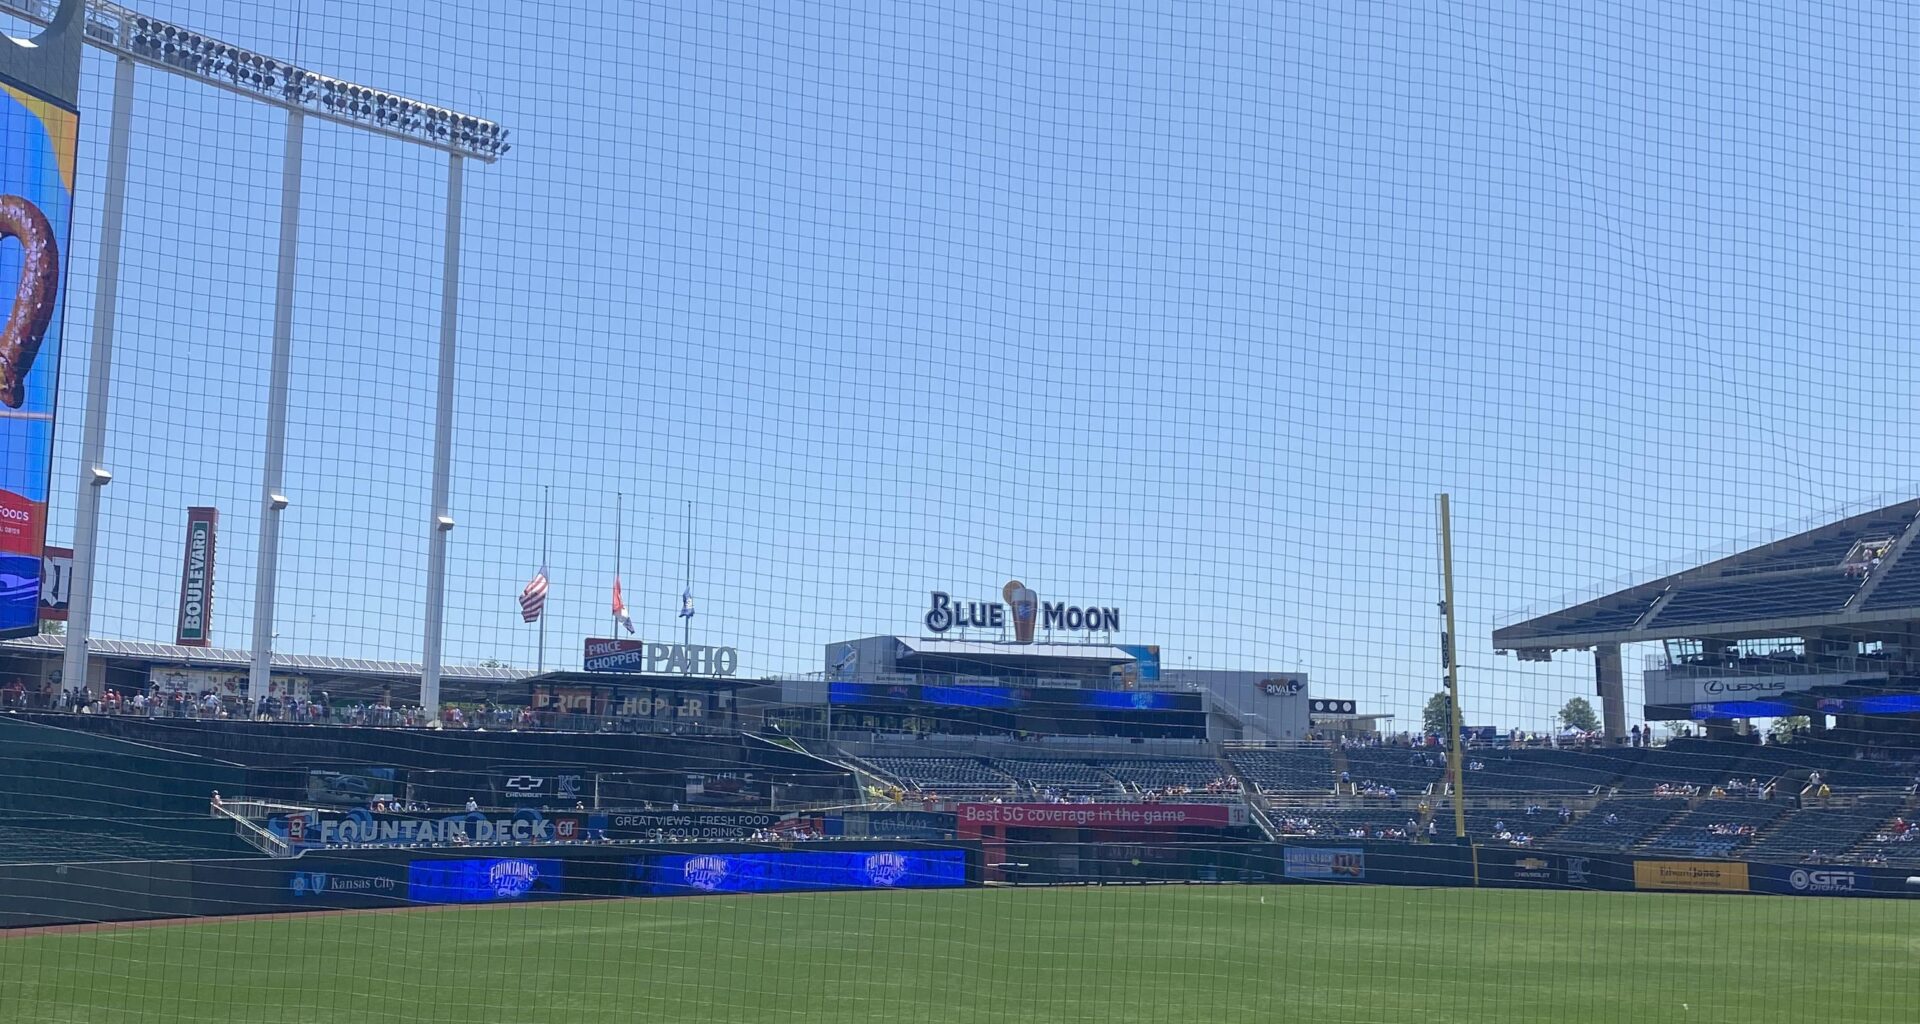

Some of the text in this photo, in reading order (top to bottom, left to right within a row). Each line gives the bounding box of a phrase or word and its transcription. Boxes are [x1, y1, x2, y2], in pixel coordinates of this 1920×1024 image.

[0, 506, 29, 521] OODS
[184, 529, 207, 630] BOULEVARD
[925, 591, 1120, 633] BLUE MOON
[588, 640, 621, 656] PRICE
[586, 652, 640, 670] CHOPPER
[647, 643, 737, 675] PATIO
[1726, 682, 1785, 691] LEXUS
[615, 815, 769, 826] GREAT VIEWS FRESH FOOD
[966, 806, 1186, 824] Best 5G coverage in the game
[321, 819, 550, 842] FOUNTAIN DECK
[703, 828, 744, 837] DRINKS
[684, 856, 726, 877] FOUNTAINS
[866, 853, 905, 872] FOUNTAINS
[490, 861, 534, 883] FOUNTAINS
[331, 876, 396, 892] Kansas City
